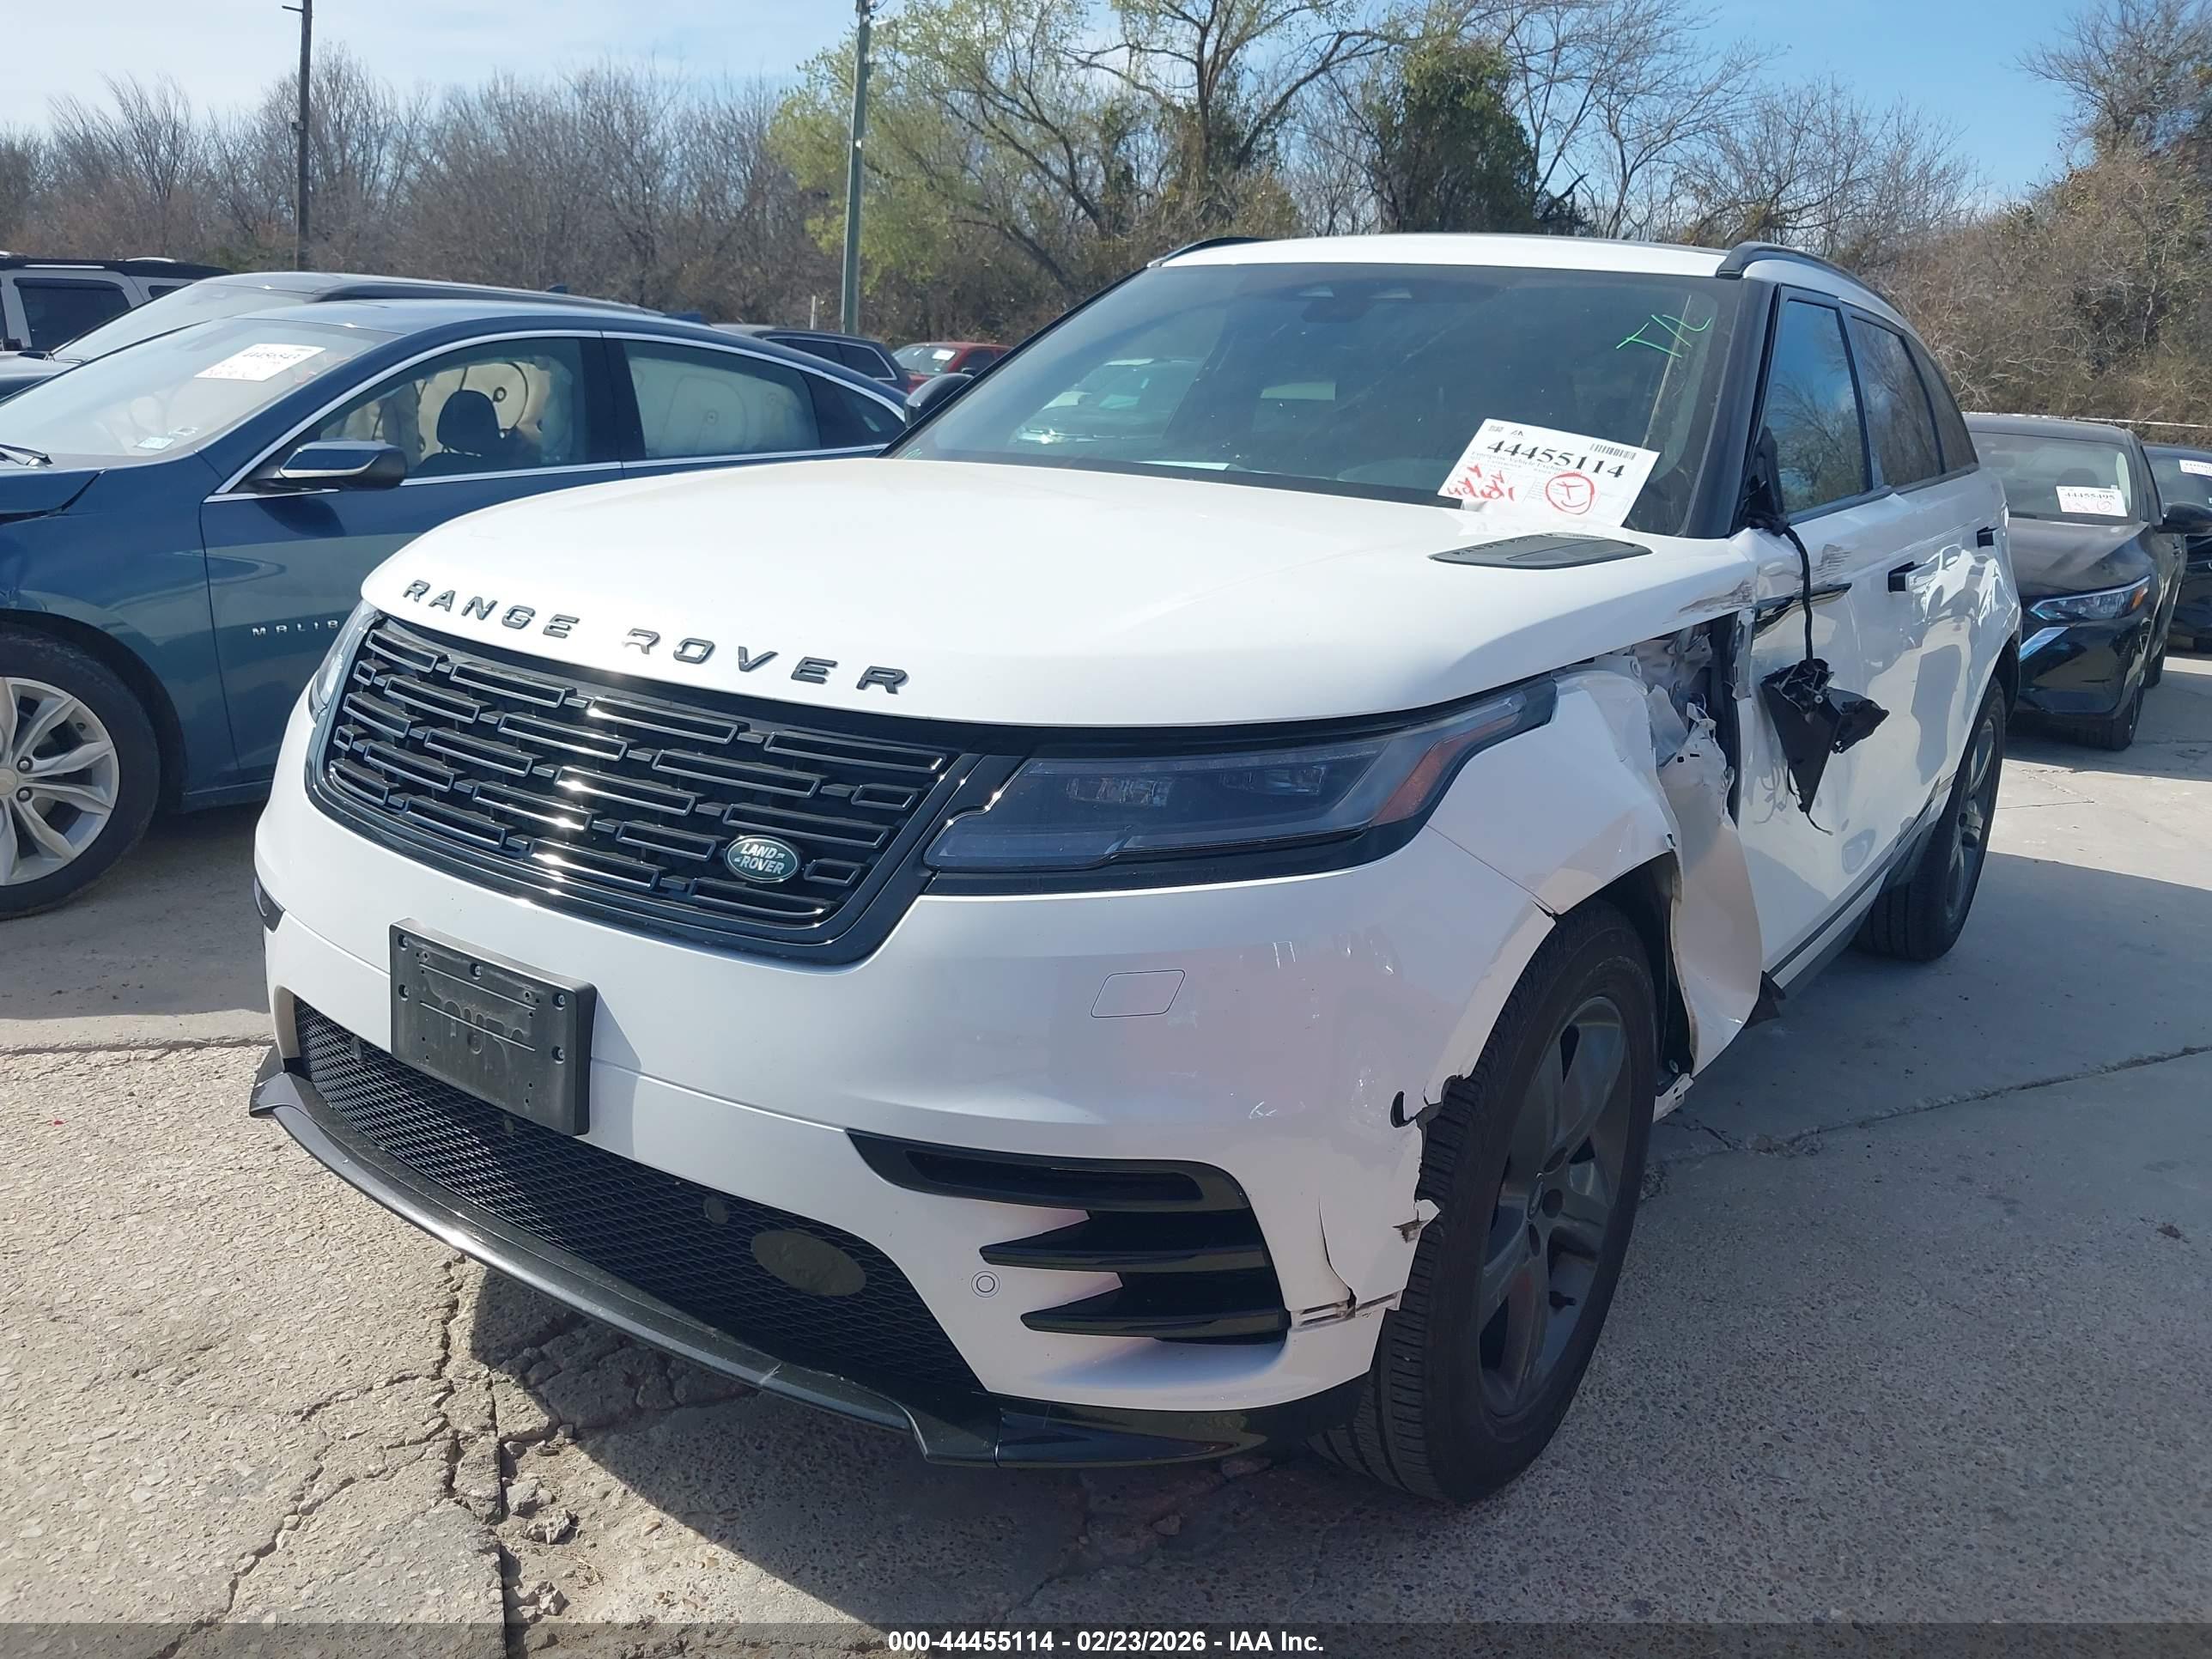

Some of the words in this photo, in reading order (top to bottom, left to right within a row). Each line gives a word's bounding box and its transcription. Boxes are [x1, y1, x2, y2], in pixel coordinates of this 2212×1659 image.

[1487, 441, 1625, 478] 44455114
[252, 619, 338, 635] MALIB
[403, 579, 580, 639] RANGE
[624, 628, 911, 696] ROVER
[740, 843, 778, 859] LAND
[739, 855, 785, 874] ROVER
